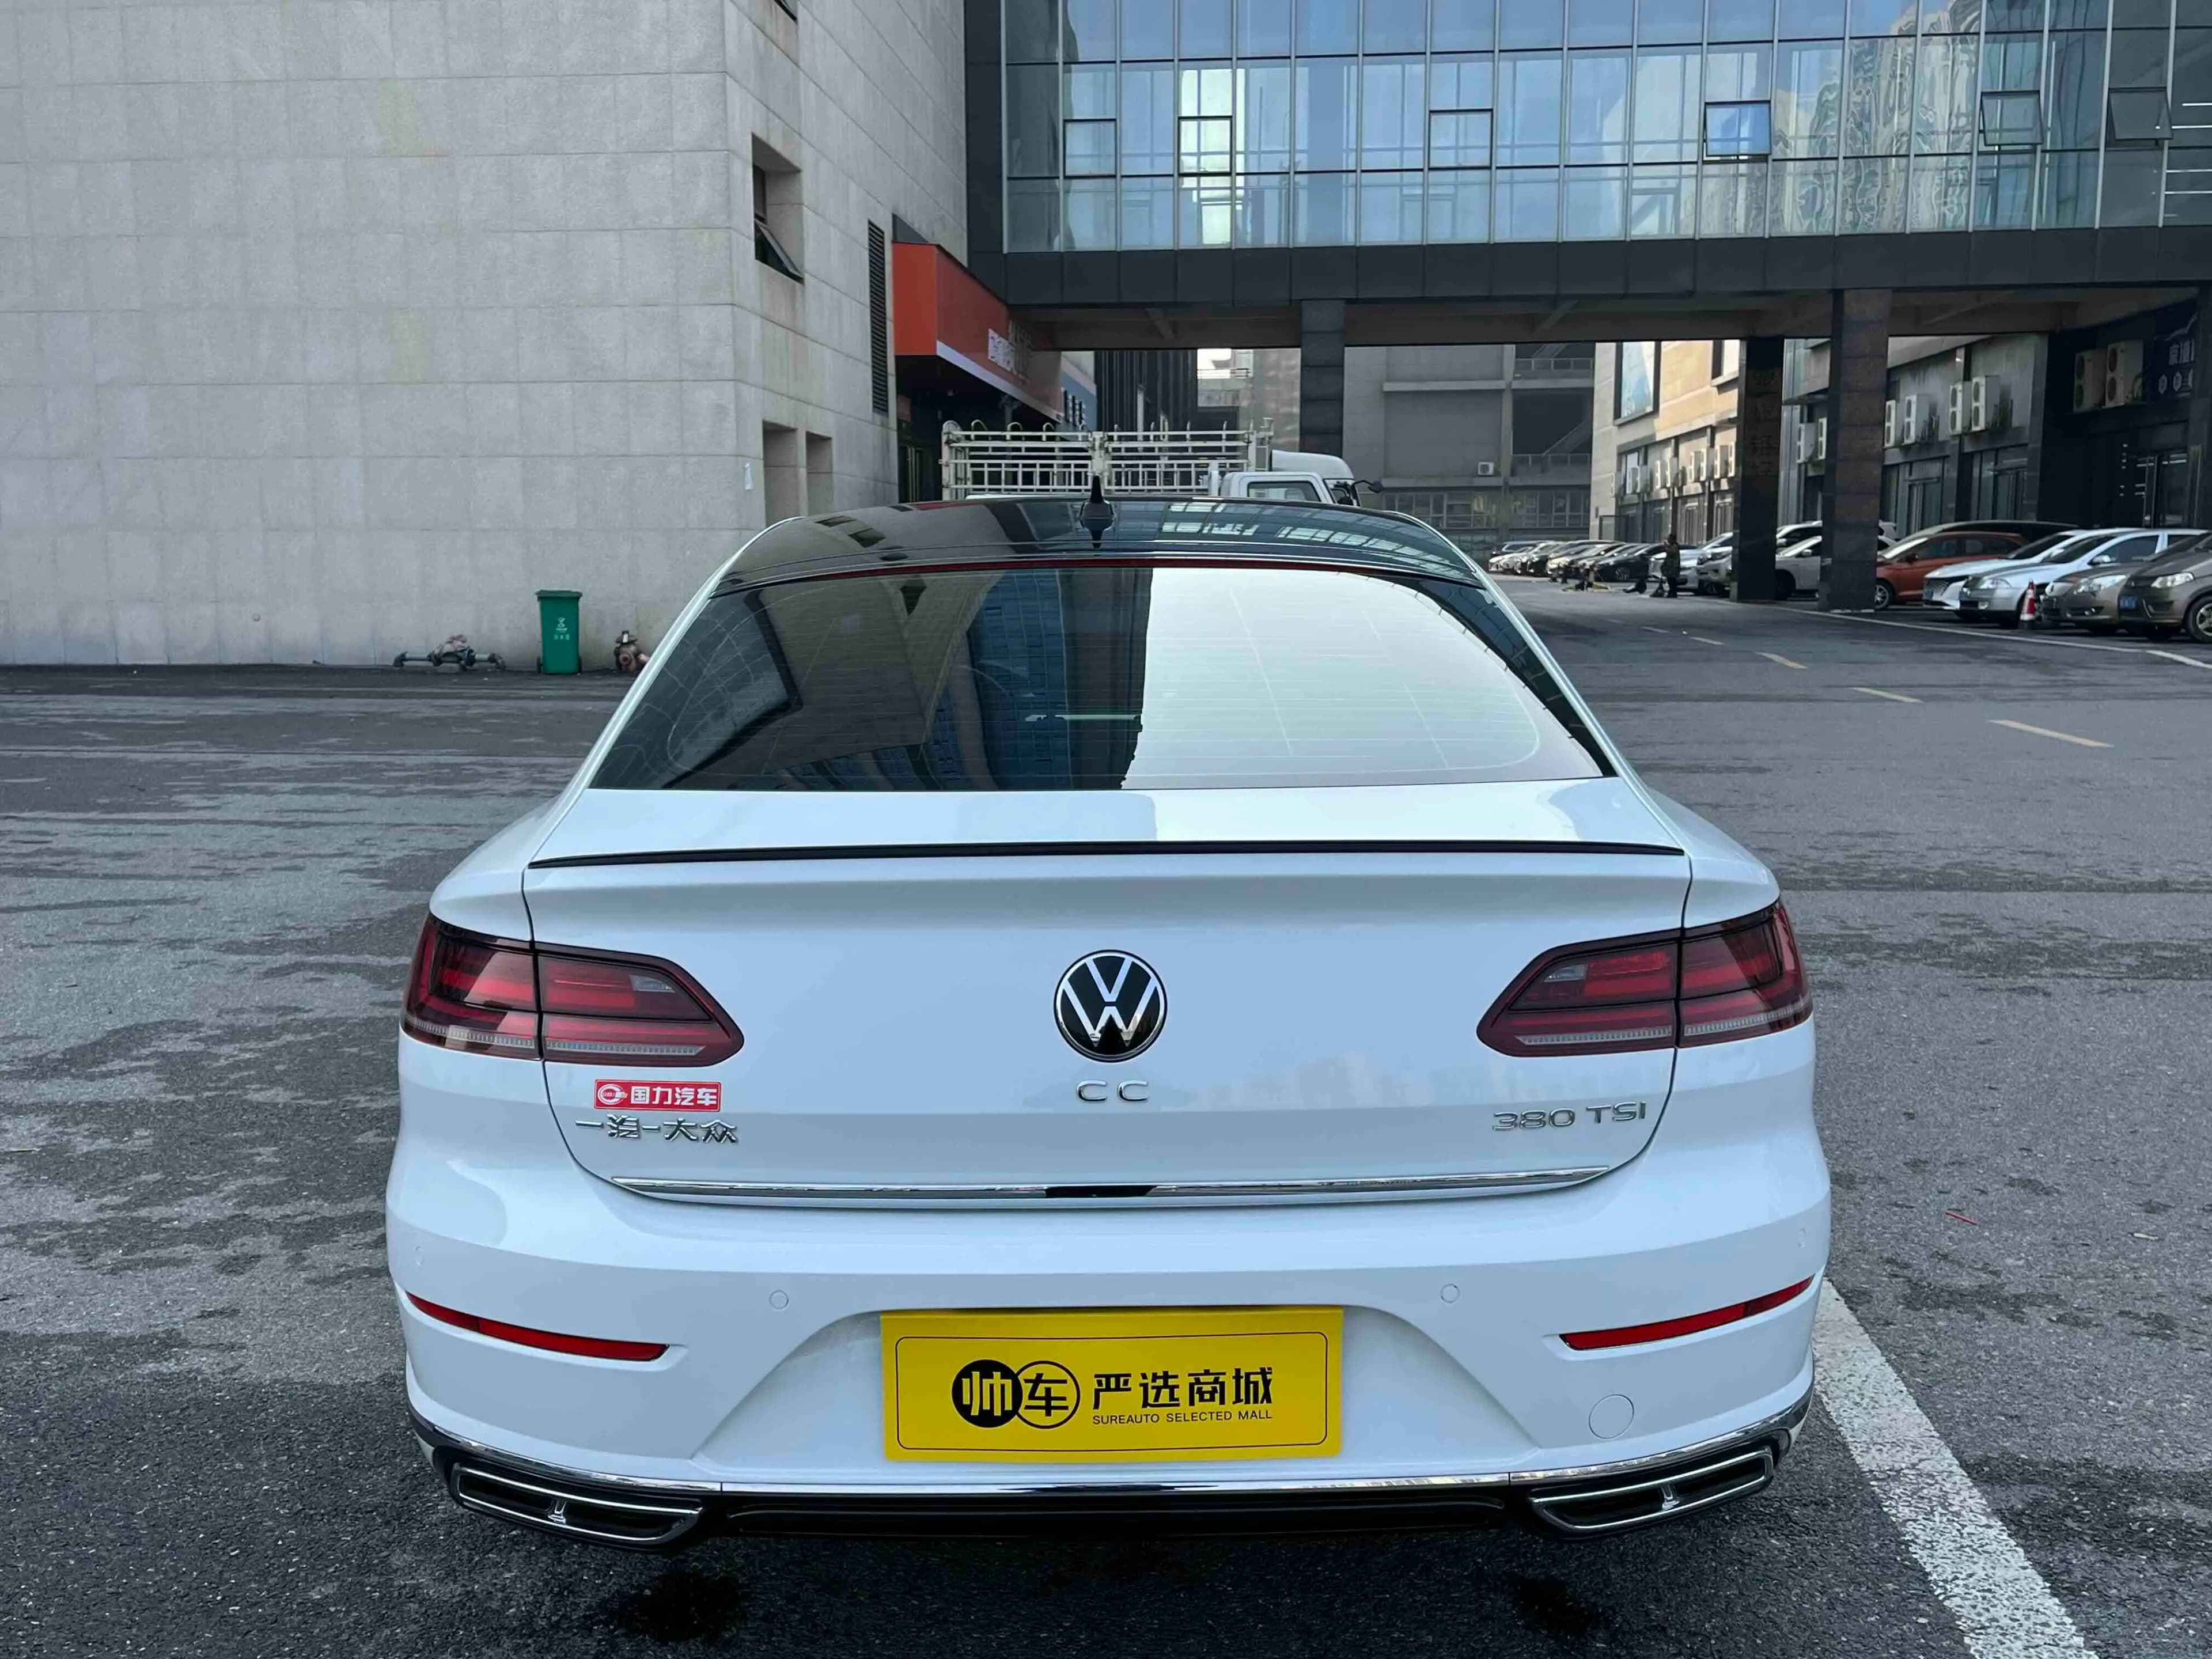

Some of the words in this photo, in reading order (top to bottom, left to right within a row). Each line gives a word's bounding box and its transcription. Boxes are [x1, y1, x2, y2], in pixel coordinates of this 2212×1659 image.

[1062, 956, 1157, 1047] VW
[630, 1086, 717, 1106] 国力汽车
[1493, 1107, 1576, 1131] 380
[1585, 1101, 1646, 1124] TSI
[961, 1371, 1069, 1417] 帅车
[1092, 1366, 1273, 1410] 严选商城
[1092, 1413, 1161, 1425] SUREAUTO
[1166, 1411, 1232, 1423] SELECTED
[1238, 1409, 1272, 1420] MALL
